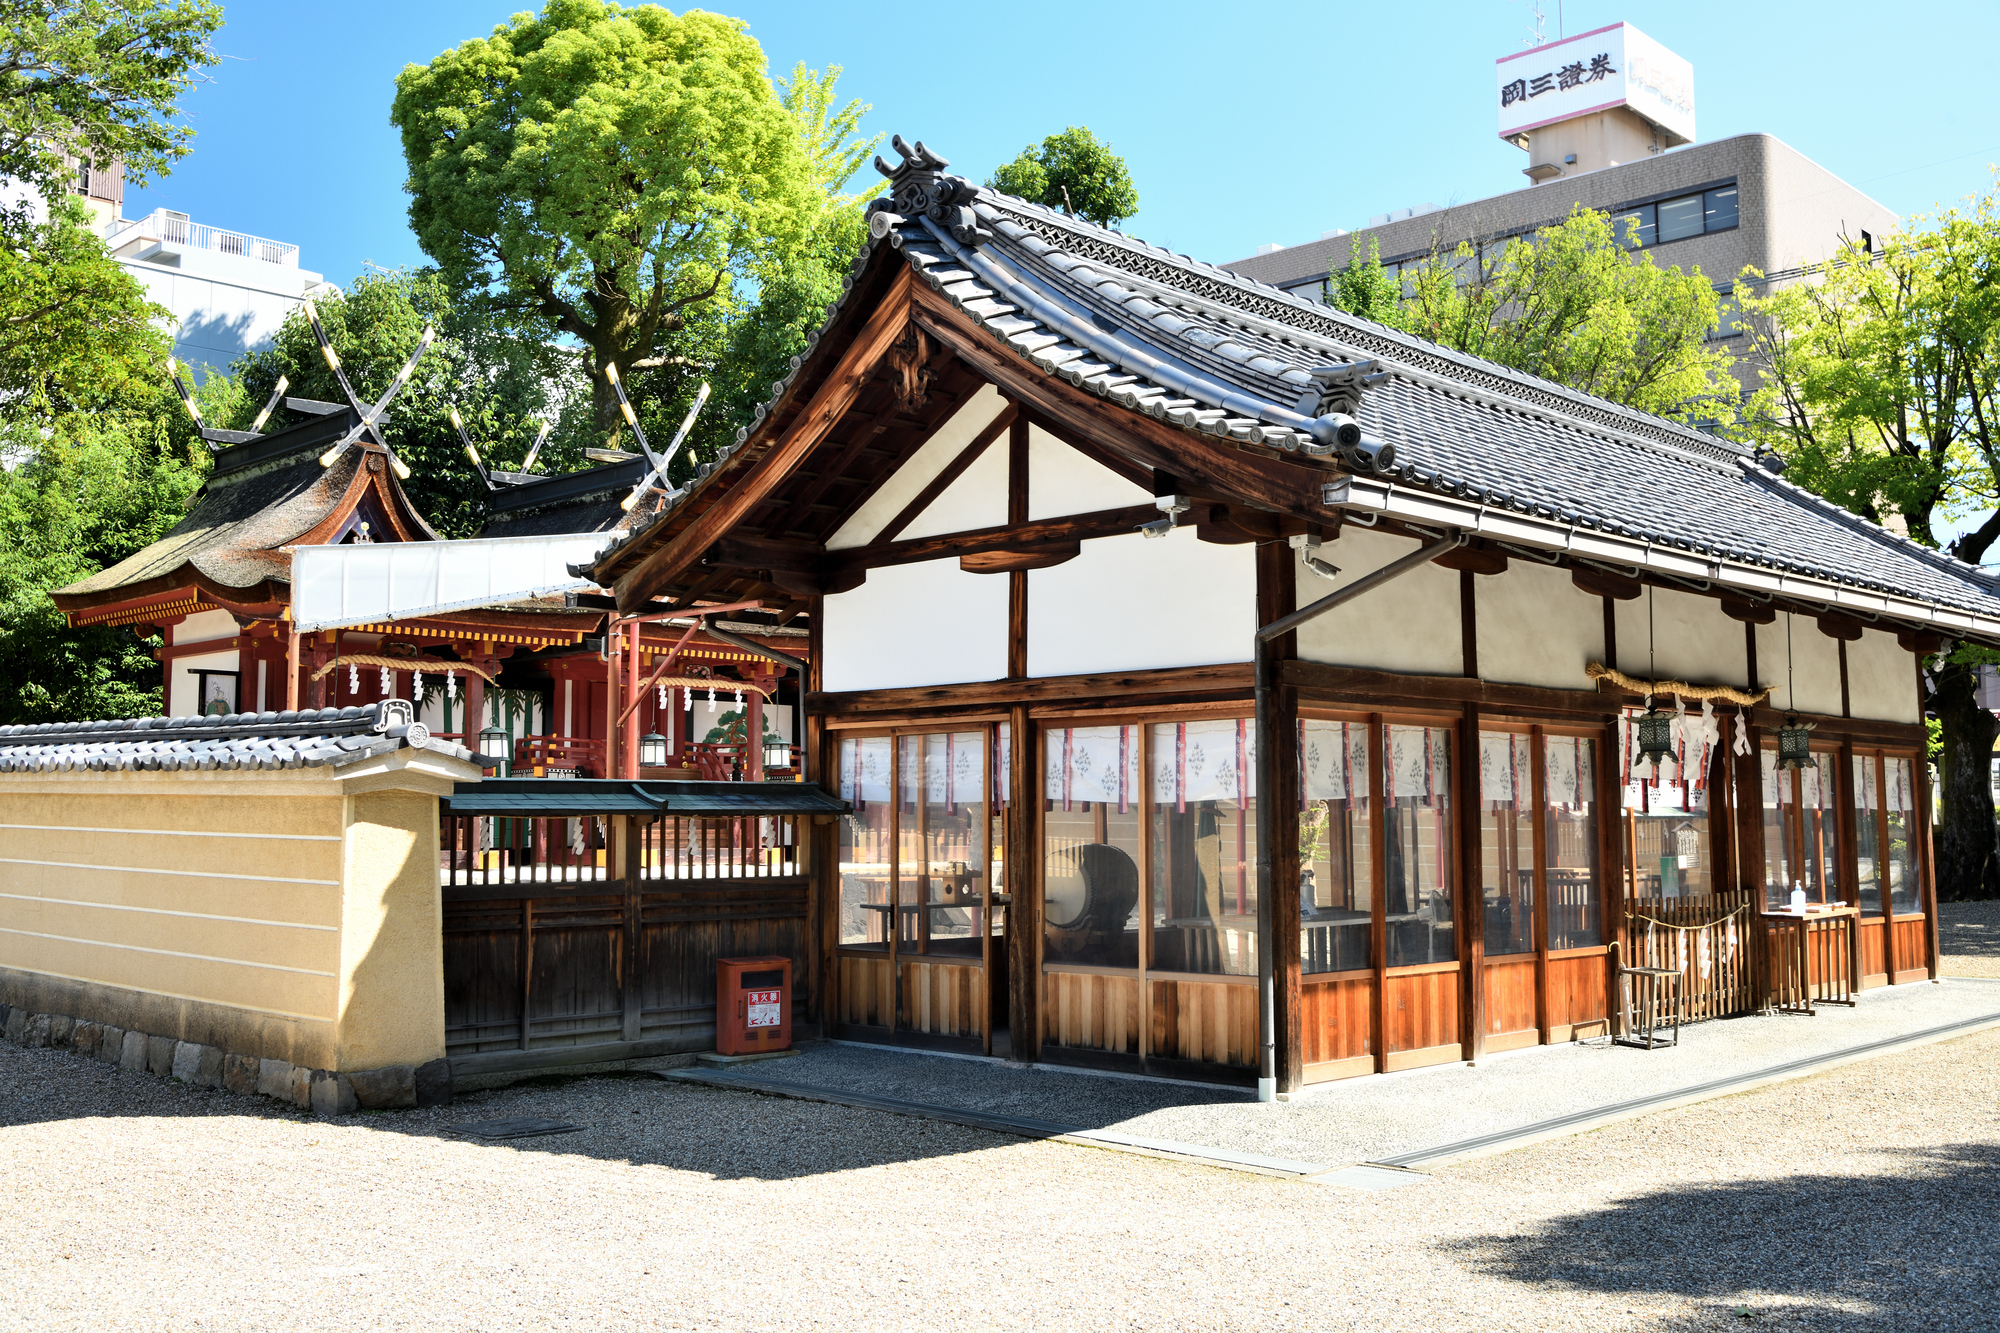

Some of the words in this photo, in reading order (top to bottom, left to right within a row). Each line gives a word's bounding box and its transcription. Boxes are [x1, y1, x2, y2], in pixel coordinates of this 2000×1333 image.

[1501, 53, 1617, 107] 岡三證券
[751, 992, 777, 1003] 消火器
